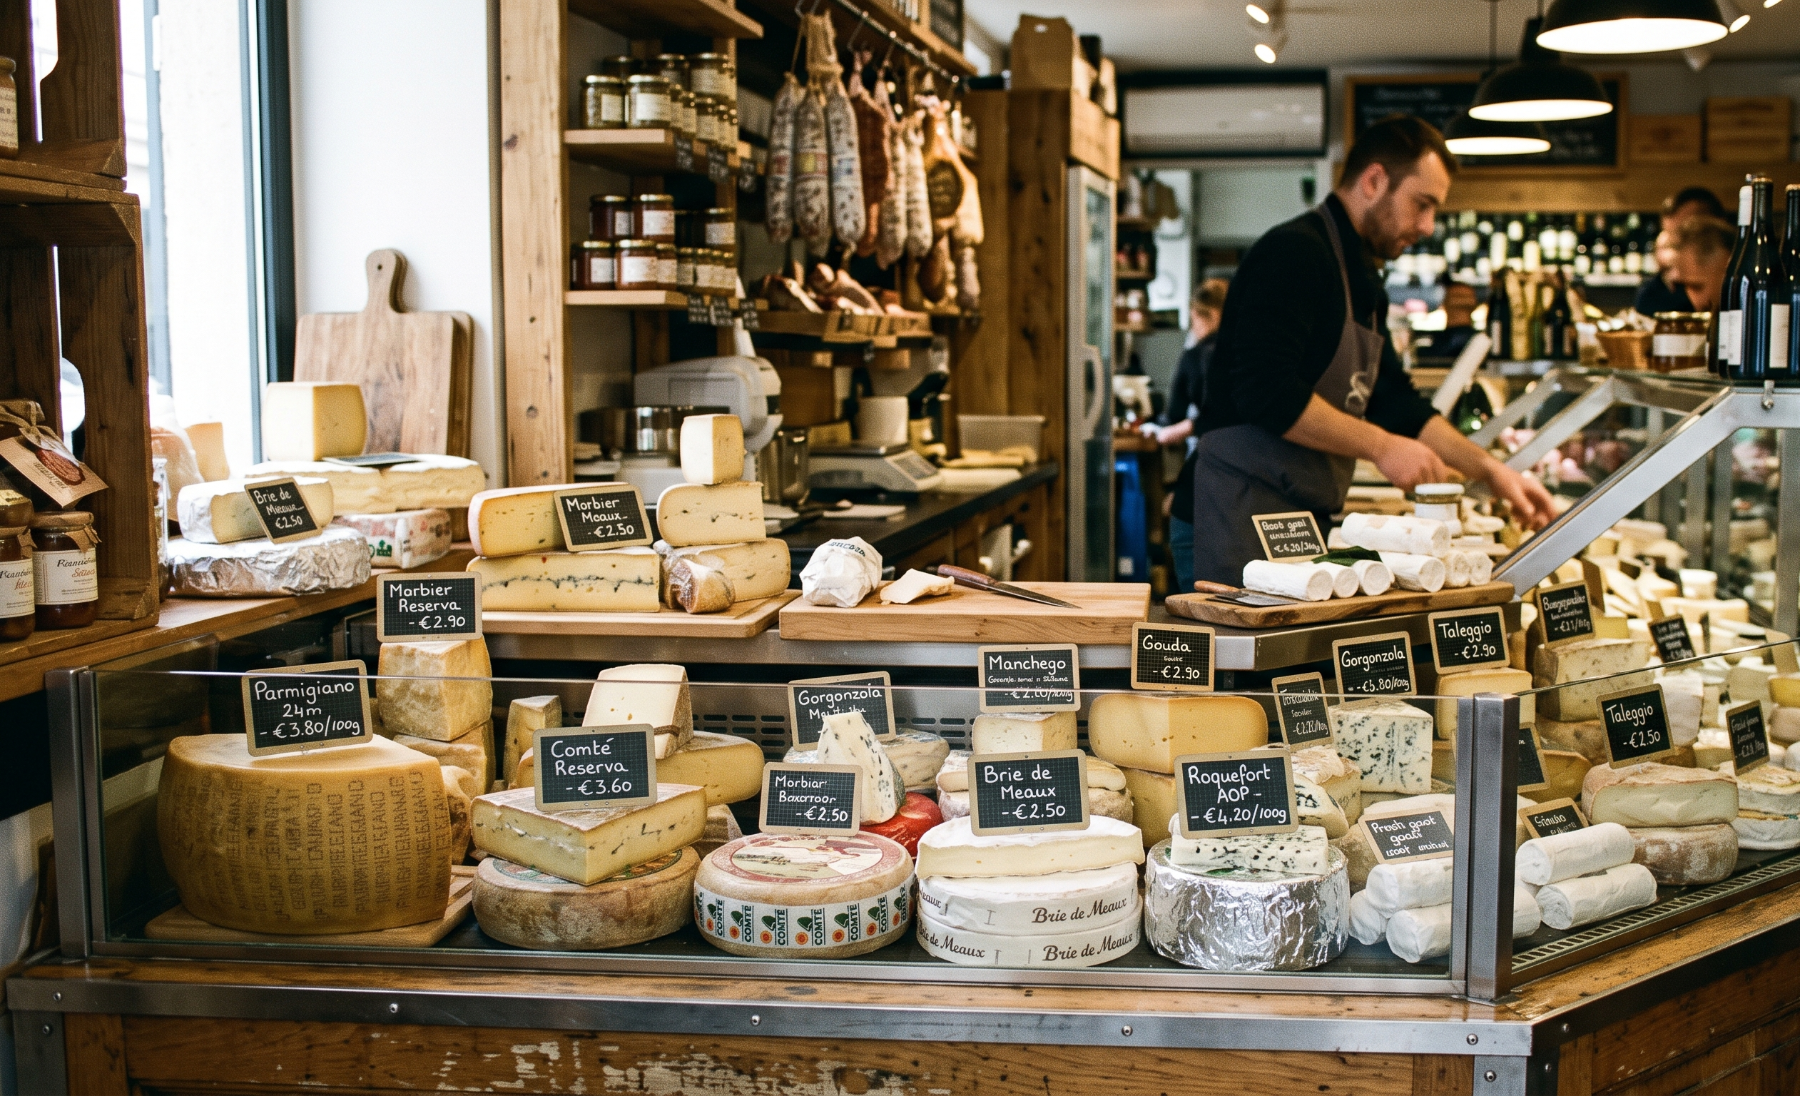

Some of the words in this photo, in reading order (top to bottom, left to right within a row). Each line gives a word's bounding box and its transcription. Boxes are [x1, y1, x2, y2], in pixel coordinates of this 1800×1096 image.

[253, 489, 278, 504] Brie
[279, 487, 292, 500] de
[566, 496, 620, 512] Morbier
[398, 598, 462, 613] Reserva
[1438, 620, 1492, 643] Taleggio
[1142, 634, 1192, 652] Gouda
[989, 655, 1066, 676] Manchego
[1341, 644, 1406, 672] Gorgonzola
[254, 681, 355, 704] Parmigiano
[798, 683, 883, 709] Gorgonzola
[1605, 702, 1654, 727] Taleggio
[551, 737, 615, 758] Comté
[555, 760, 629, 776] Reserva
[984, 765, 1024, 784] Brie
[1031, 763, 1053, 780] de
[1188, 763, 1271, 789] Roquefort
[1000, 785, 1057, 800] Meaux
[1217, 786, 1250, 804] AOP
[1031, 907, 1067, 924] Brie
[1070, 906, 1085, 921] de
[1086, 898, 1128, 918] Meaux
[776, 909, 786, 946] COMTE
[813, 909, 823, 946] COMTE
[849, 904, 859, 941] COMTE
[930, 933, 940, 947] de
[940, 934, 986, 958] Meaux
[1042, 944, 1078, 961] Brie
[1080, 943, 1096, 958] de
